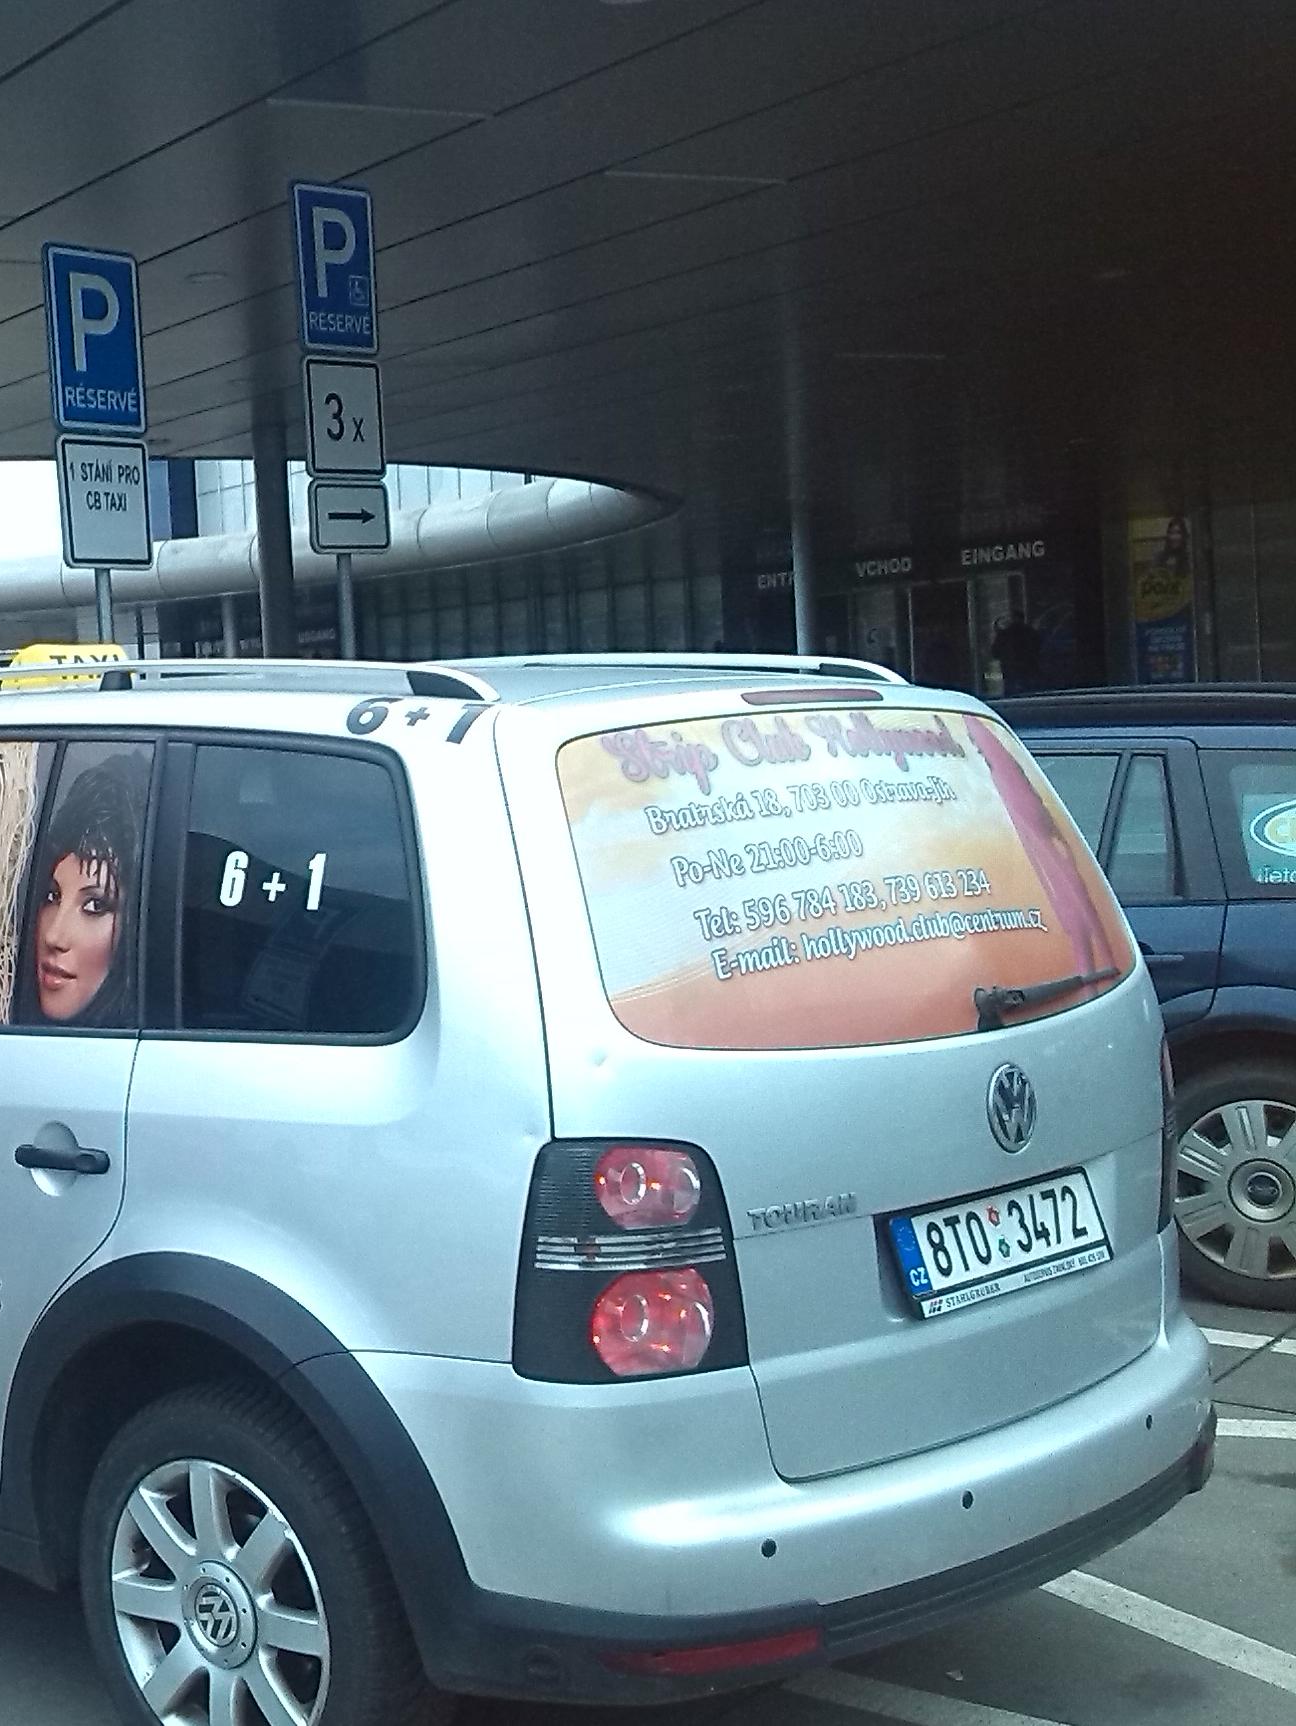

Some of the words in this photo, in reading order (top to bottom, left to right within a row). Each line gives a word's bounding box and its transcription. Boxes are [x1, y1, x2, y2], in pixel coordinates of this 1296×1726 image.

[312, 206, 356, 297] P
[69, 272, 120, 372] P
[308, 310, 372, 335] RÉSERVÉ
[65, 383, 138, 413] RÉSERVÉ
[324, 392, 345, 442] 3
[69, 463, 76, 483] 1
[80, 458, 114, 484] STÁNÍ
[117, 463, 141, 485] PRO
[86, 491, 102, 512] CB
[103, 492, 128, 514] TAXI
[960, 539, 1046, 568] EINGANG
[346, 697, 404, 735] 6
[446, 703, 495, 745] 1
[721, 716, 811, 767] Club
[644, 790, 754, 836] Bratrská
[752, 787, 793, 819] 18,
[790, 781, 830, 813] 703
[829, 778, 861, 807] 00
[219, 850, 249, 907] 6
[306, 853, 326, 911] 1
[670, 848, 747, 888] Po-Ne
[745, 828, 865, 874] 21:00-6:00
[692, 907, 743, 942] Tel:
[742, 891, 791, 932] 596
[791, 885, 838, 924] 784
[836, 877, 888, 915] 183,
[883, 873, 922, 907] 739
[924, 870, 958, 902] 613
[957, 868, 992, 898] 234
[711, 939, 801, 982] E-mail:
[802, 907, 1048, 961] hollywood.club@centrum.cz
[746, 1191, 857, 1232] TOURAN
[1007, 1185, 1089, 1253] 3472
[909, 1266, 929, 1287] CZ
